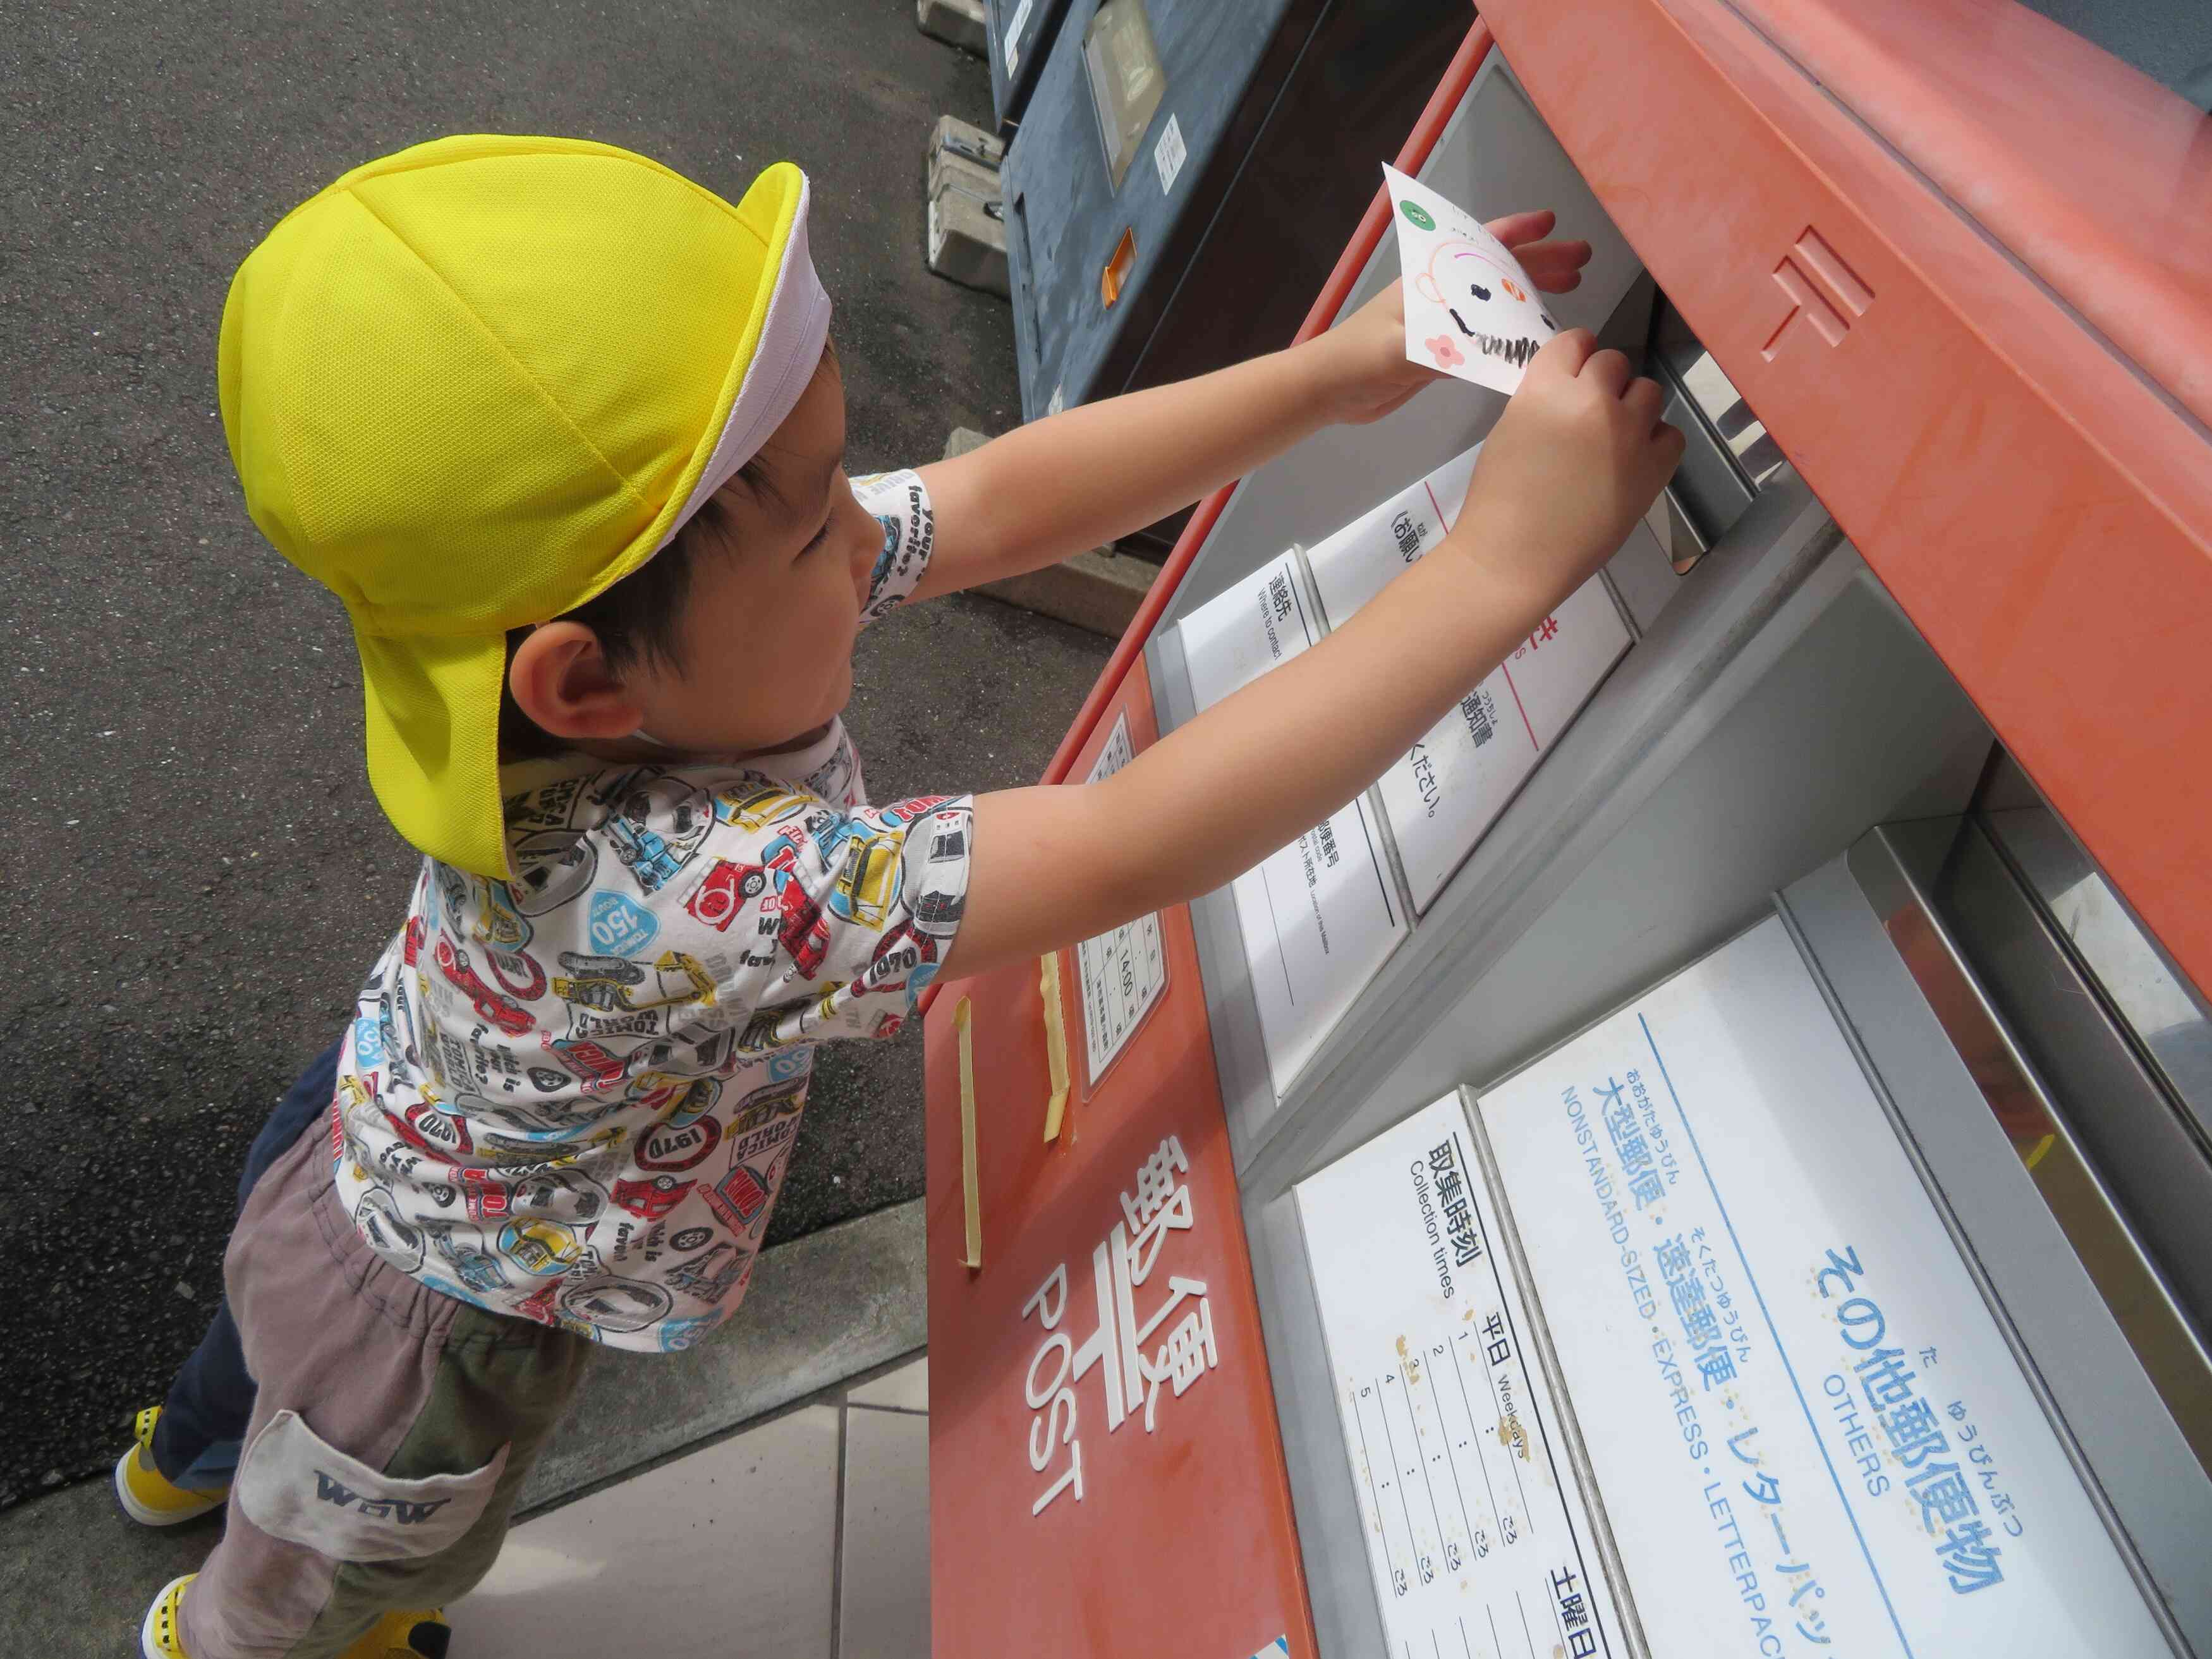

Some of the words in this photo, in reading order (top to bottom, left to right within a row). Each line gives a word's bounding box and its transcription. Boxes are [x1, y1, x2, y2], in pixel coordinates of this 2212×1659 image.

[1258, 588, 1270, 616] Where
[1267, 627, 1282, 660] contact
[1268, 571, 1292, 622] 連絡先
[1461, 691, 1493, 748] 通知書
[1315, 846, 1323, 861] code
[870, 947, 917, 984] 1970
[1120, 950, 1133, 997] 14:00
[649, 1129, 702, 1159] 1970
[1626, 1067, 1680, 1186] おおがたゆうびん
[1410, 1161, 1440, 1246] Collection
[1433, 1247, 1454, 1299] times
[1428, 1139, 1483, 1268] 取集時刻
[1119, 1135, 1218, 1433] 郵便
[1691, 1227, 1751, 1363] そくたつゆうびん
[1433, 1344, 1444, 1357] 2
[1457, 1332, 1469, 1341] 1
[1481, 1311, 1512, 1366] 平日
[1919, 1346, 1938, 1369] た
[1022, 1263, 1083, 1517] POST
[1361, 1387, 1371, 1398] 5
[1385, 1375, 1395, 1384] 4
[1818, 1246, 2004, 1594] その他郵便物
[1823, 1374, 1890, 1497] OTHERS
[1652, 1339, 1709, 1460] EXPRESS
[1704, 1481, 1785, 1659] LETTERPAC
[1947, 1400, 2022, 1538] ゆうびんぶつ
[1551, 1566, 1596, 1659] 土曜日
